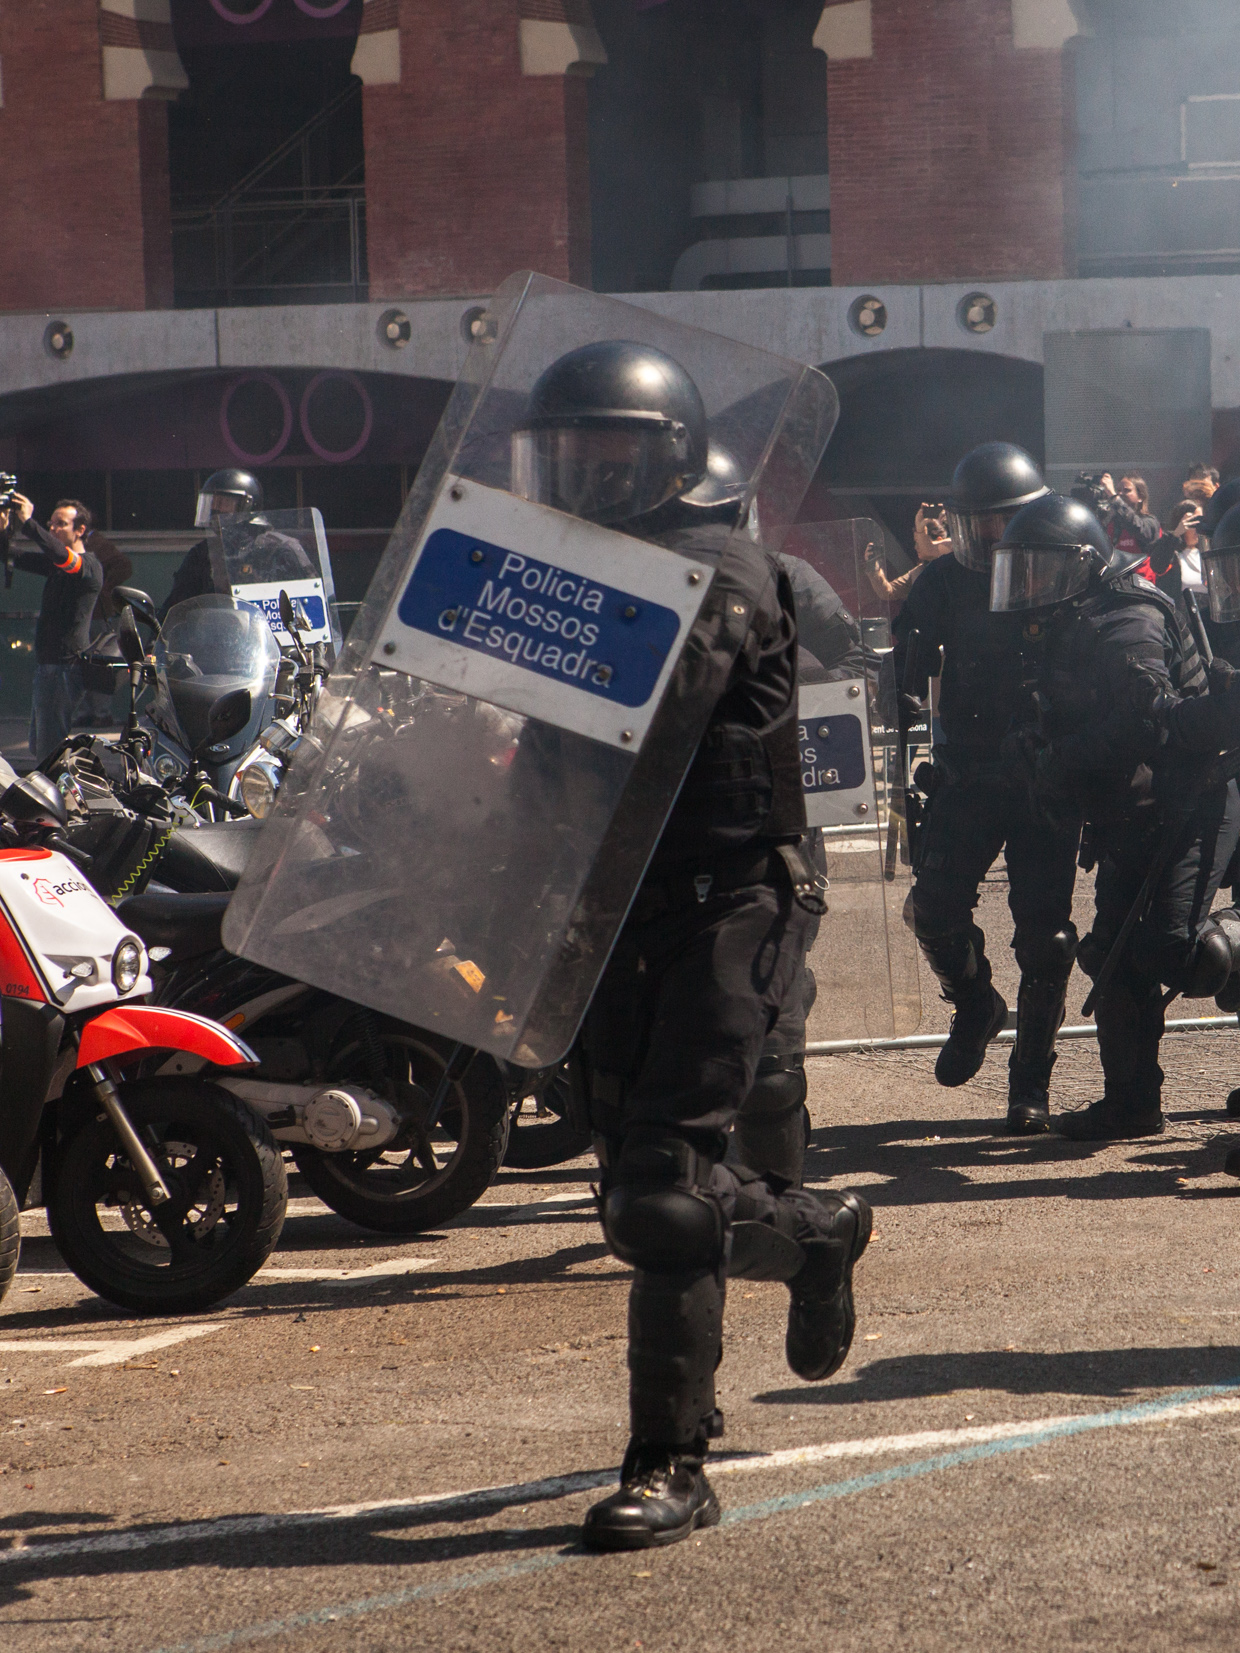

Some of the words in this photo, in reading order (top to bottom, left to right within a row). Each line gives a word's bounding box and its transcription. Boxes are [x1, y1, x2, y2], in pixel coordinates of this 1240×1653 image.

[476, 580, 600, 646] Mossos
[498, 553, 604, 614] Policia
[437, 605, 613, 689] d'Esquadra
